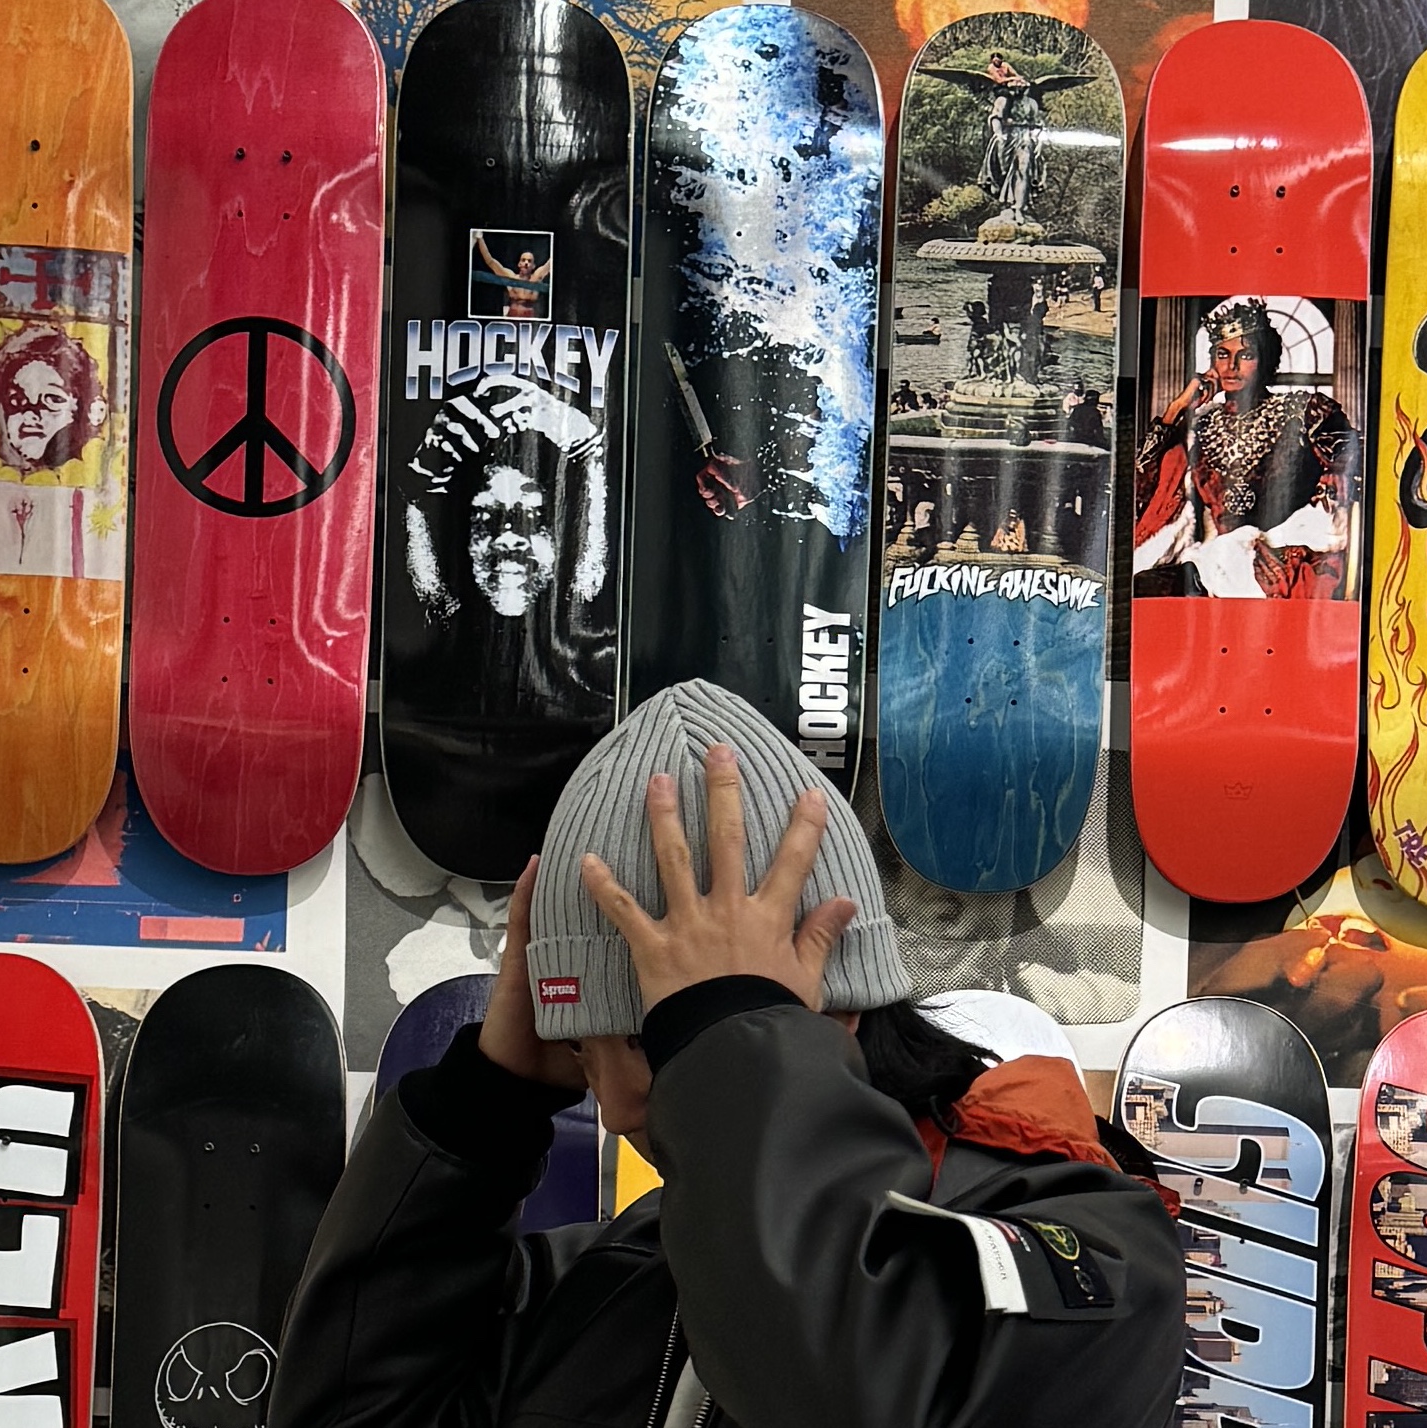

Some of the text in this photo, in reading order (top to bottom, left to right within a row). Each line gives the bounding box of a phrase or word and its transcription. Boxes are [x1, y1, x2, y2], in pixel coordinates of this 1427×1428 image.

[405, 319, 620, 408] HOCKEY
[888, 563, 1104, 612] FUCKING AWESOME
